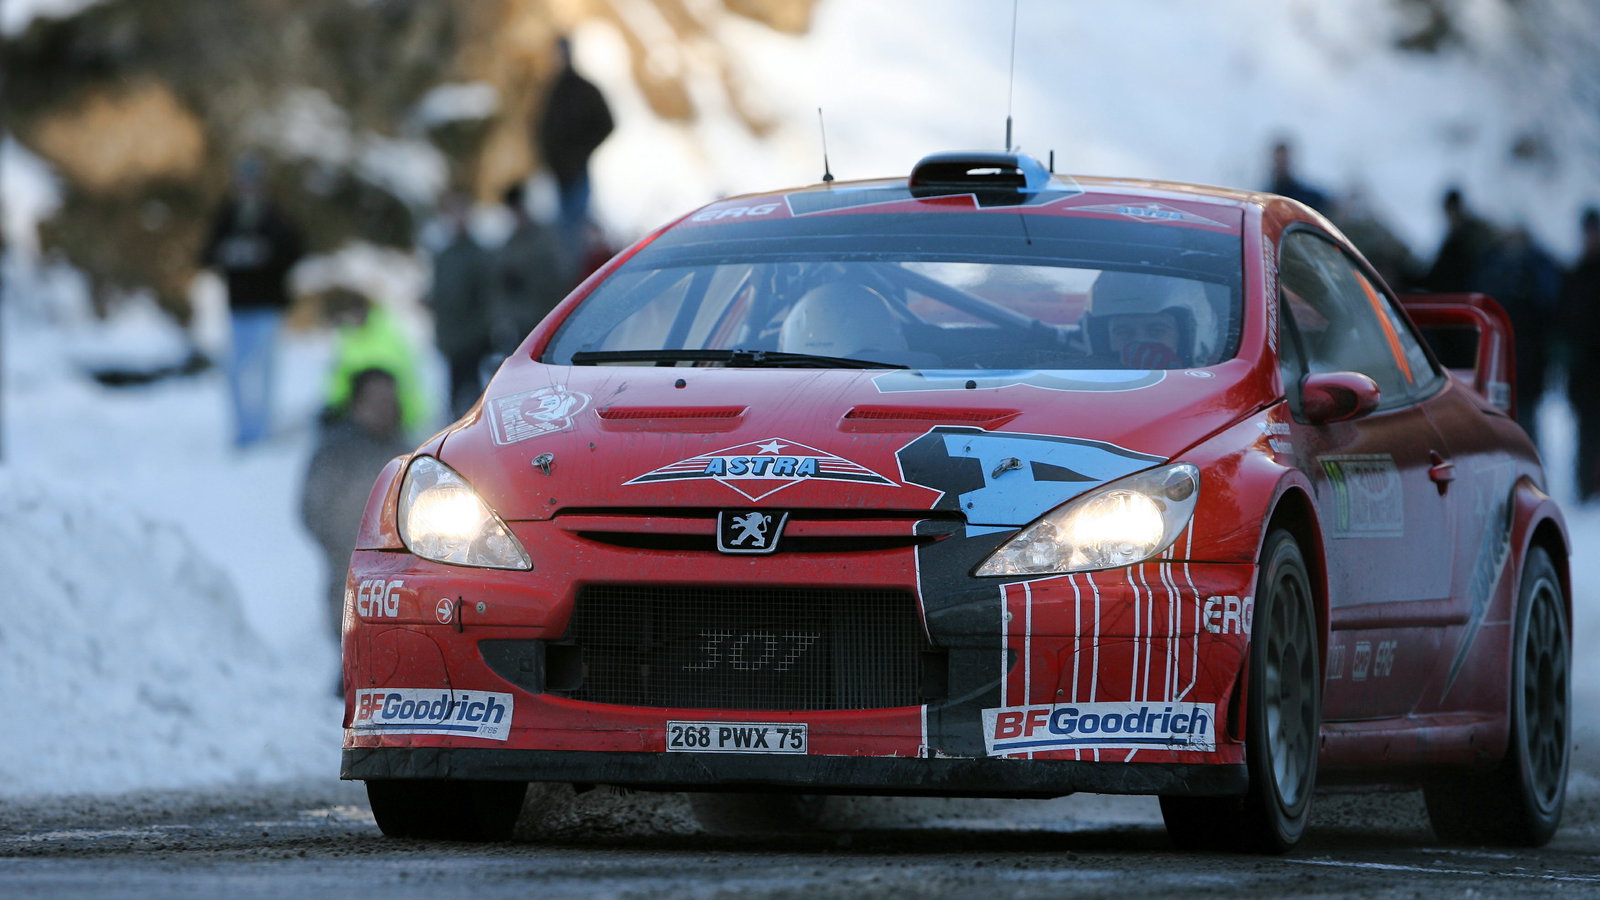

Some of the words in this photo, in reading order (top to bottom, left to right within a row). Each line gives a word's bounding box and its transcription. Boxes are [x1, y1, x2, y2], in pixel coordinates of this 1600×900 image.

[704, 457, 821, 477] ASTRA
[357, 580, 405, 617] ERG
[1203, 595, 1255, 635] ERG
[357, 692, 506, 724] BFGoodrich
[993, 706, 1208, 740] BFGoodrich
[670, 726, 711, 748] 268
[718, 727, 769, 749] PWX
[776, 728, 803, 750] 75
